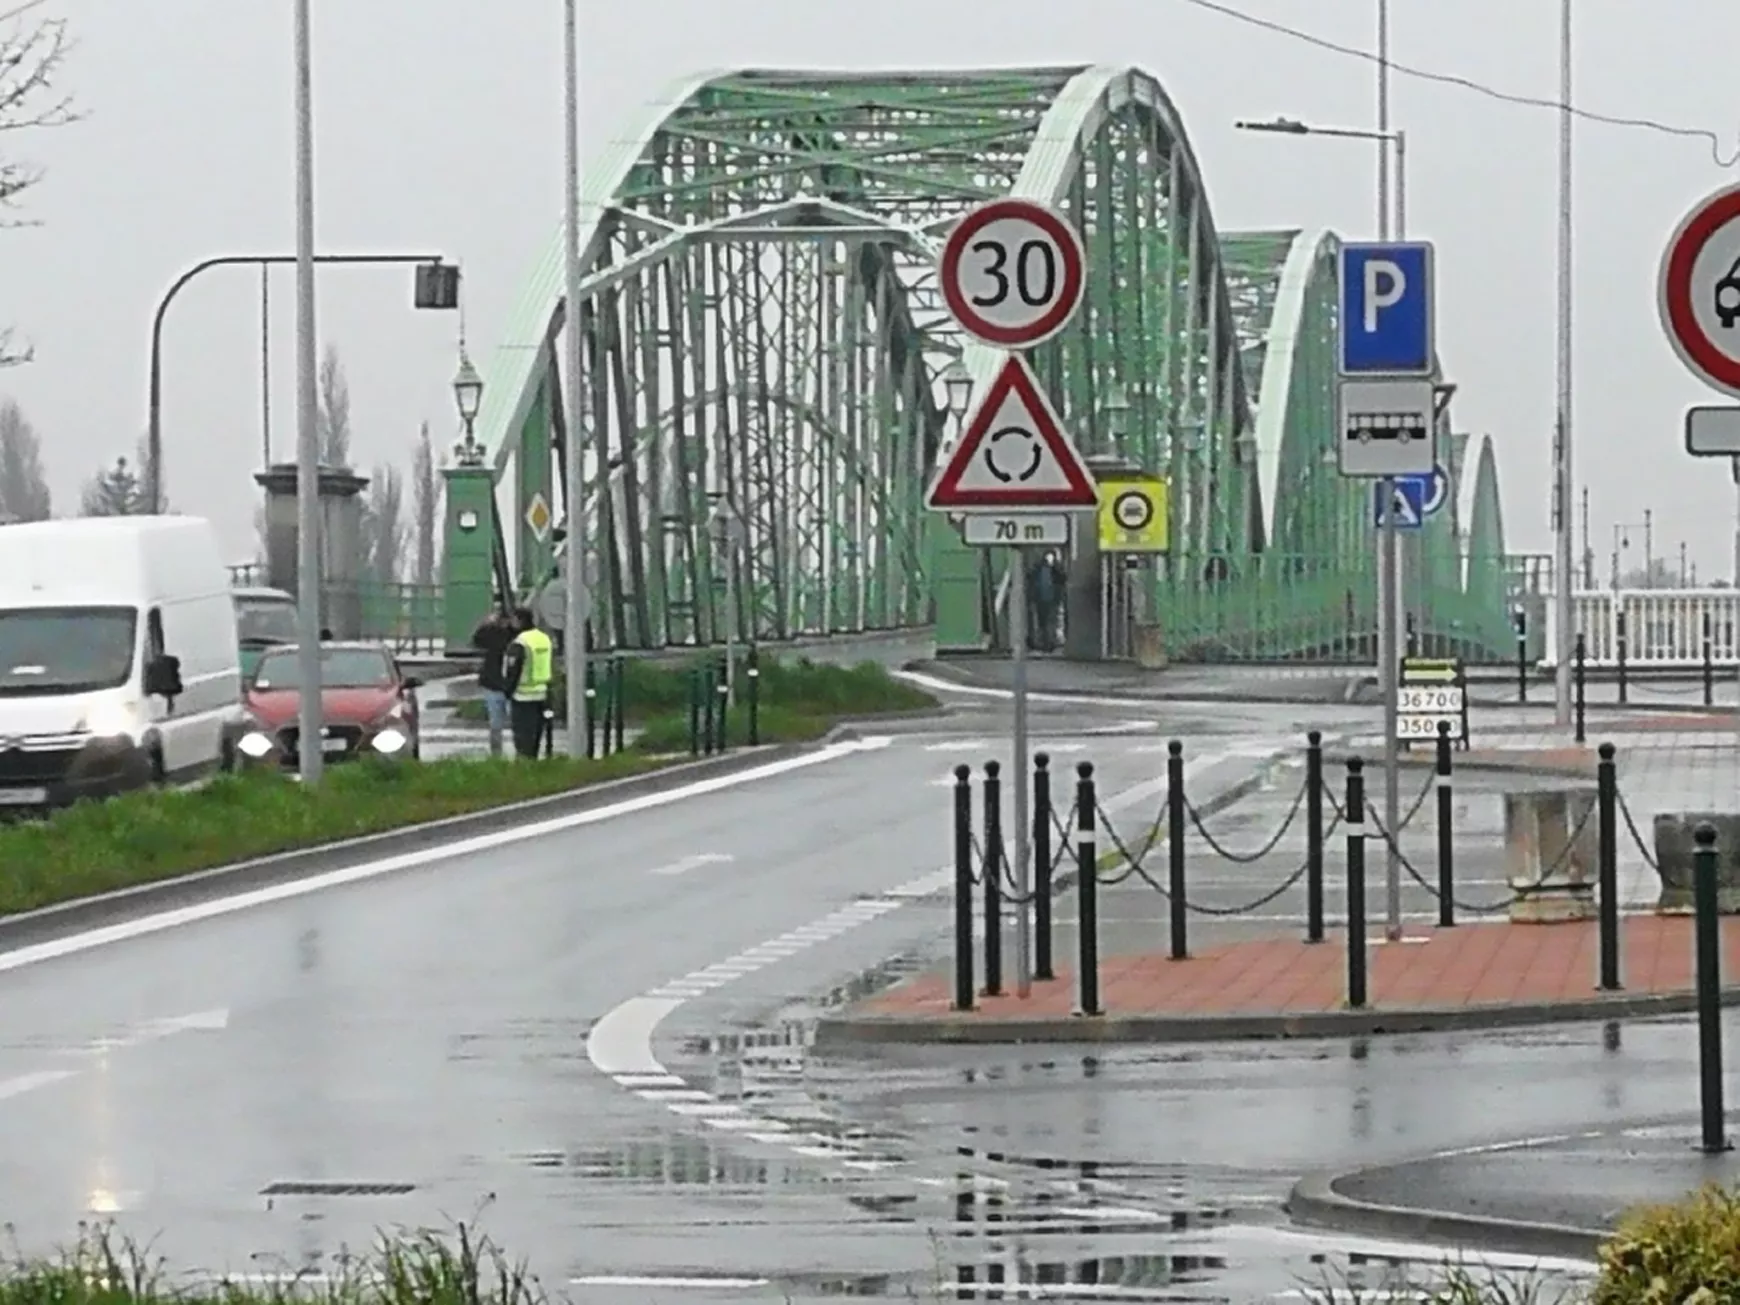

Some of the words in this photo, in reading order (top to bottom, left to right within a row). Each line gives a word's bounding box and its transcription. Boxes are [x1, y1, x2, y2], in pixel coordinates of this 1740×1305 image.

[972, 240, 1055, 306] 30
[1364, 260, 1406, 333] P
[994, 520, 1017, 540] 70
[1024, 524, 1044, 540] m
